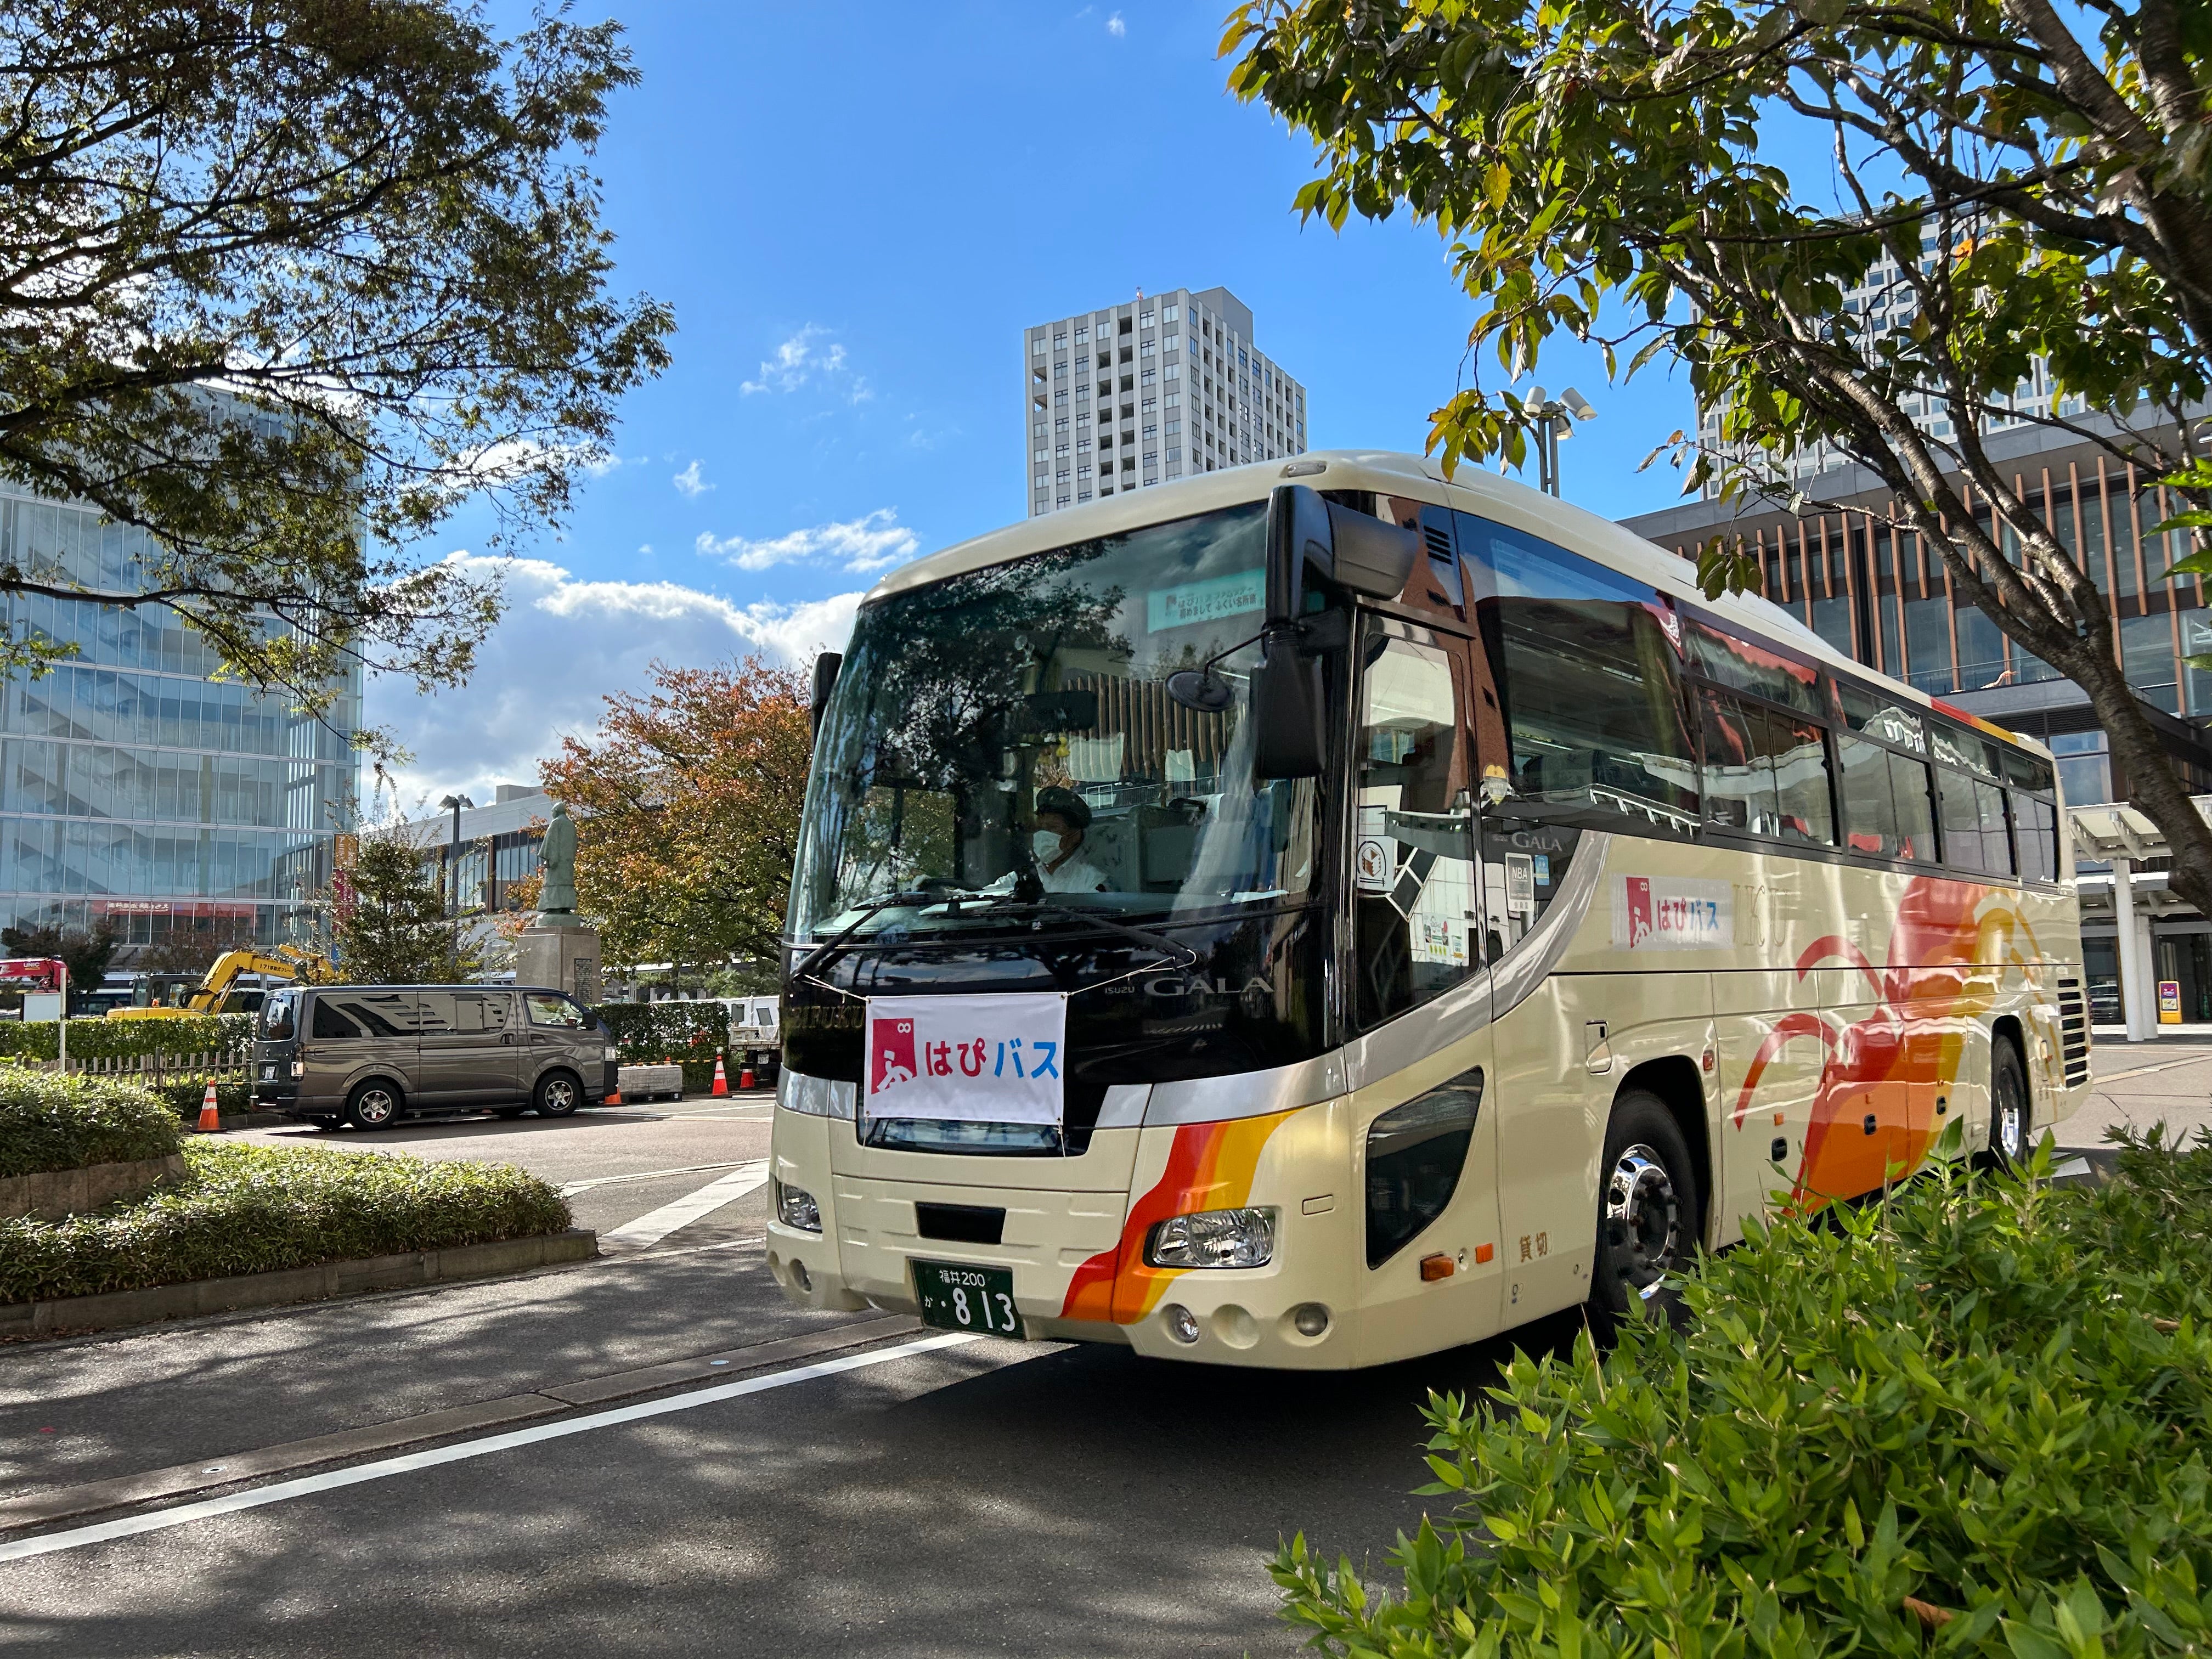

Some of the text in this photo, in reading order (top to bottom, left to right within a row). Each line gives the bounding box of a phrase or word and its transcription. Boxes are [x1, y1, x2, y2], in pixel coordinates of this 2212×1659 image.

[1511, 832, 1562, 851] GALA
[1512, 866, 1528, 880] NBA
[1657, 897, 1719, 931] はぴバス
[1104, 977, 1274, 996] ISUZU GALA
[925, 1037, 1059, 1080] はぴバス
[1519, 1232, 1548, 1263] 貸切
[939, 1269, 986, 1288] 福井200
